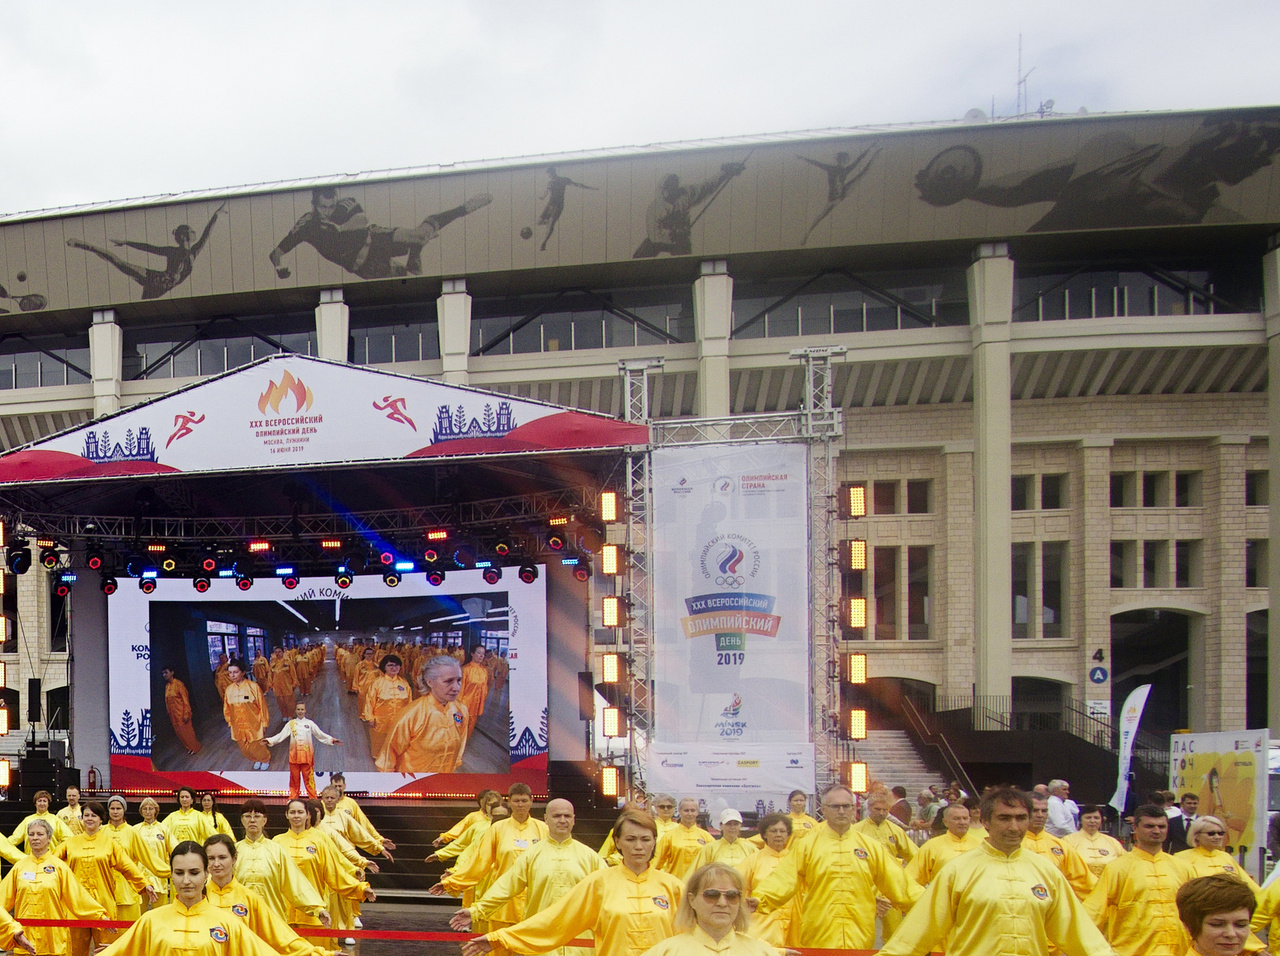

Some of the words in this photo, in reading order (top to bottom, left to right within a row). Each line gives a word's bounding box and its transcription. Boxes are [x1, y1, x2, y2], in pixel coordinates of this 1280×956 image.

[265, 414, 323, 427] ВСЕРОССИЙСКИЙ
[255, 427, 300, 437] ОЛИМПИЙСКИЙ
[302, 427, 317, 435] ДЕНЬ
[742, 473, 788, 482] ОЛИМПИЙСКАЯ
[700, 533, 725, 579] ОЛИМПИЙСКИЙ
[727, 533, 756, 550] КОМИТЕТ
[749, 550, 760, 578] РОССИИ
[707, 597, 768, 609] ВСЕРОССИЙСКИЙ
[688, 614, 773, 633] ОЛИМПИЙСКИЙ
[720, 637, 742, 646] ДЕНЬ
[717, 653, 745, 665] 2019
[1092, 649, 1104, 662] 4
[1093, 670, 1103, 679] A
[720, 728, 743, 736] 2019
